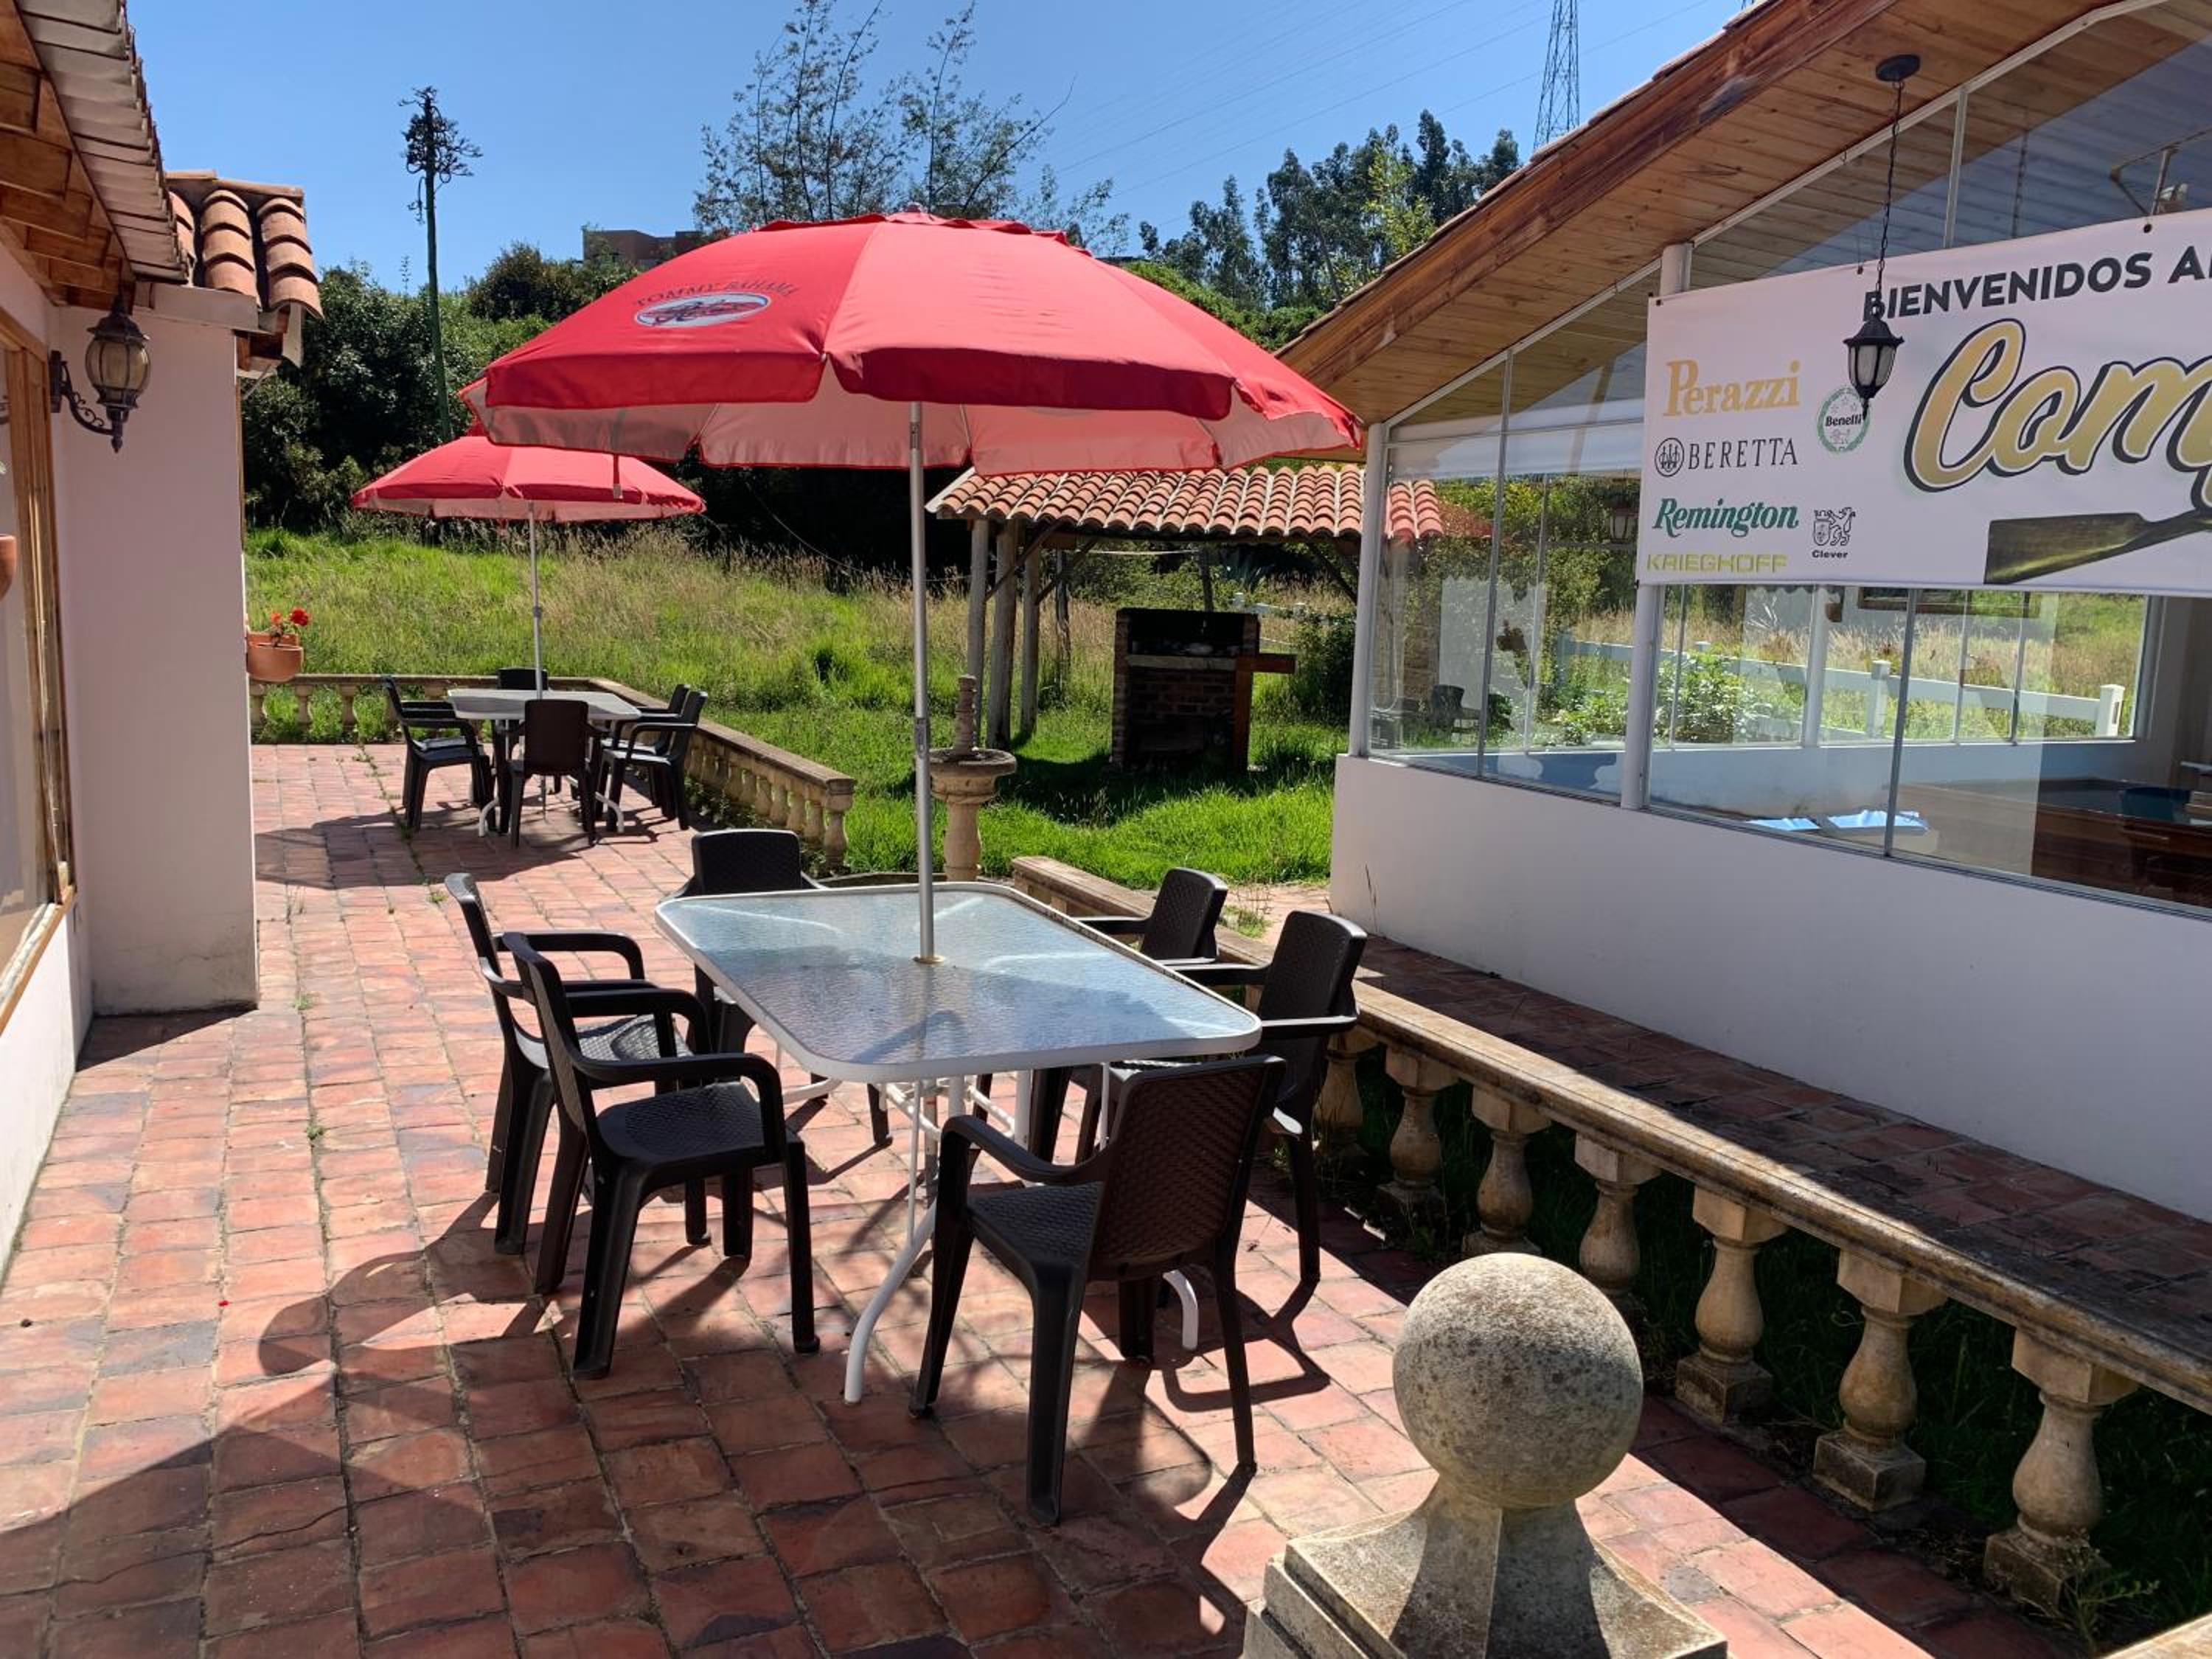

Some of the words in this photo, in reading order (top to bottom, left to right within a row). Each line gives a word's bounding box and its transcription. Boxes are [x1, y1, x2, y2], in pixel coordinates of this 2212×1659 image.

[1863, 251, 2152, 321] BIENVENIDOS
[2167, 246, 2212, 283] A
[1663, 359, 1800, 417] Perazzi
[1825, 414, 1862, 427] Benelli
[1904, 318, 2212, 512] Cam
[1688, 437, 1798, 470] BERETTA
[1652, 498, 1799, 538] Remington
[1646, 554, 1787, 572] KRIEGHOFF
[1812, 549, 1848, 558] Clever
